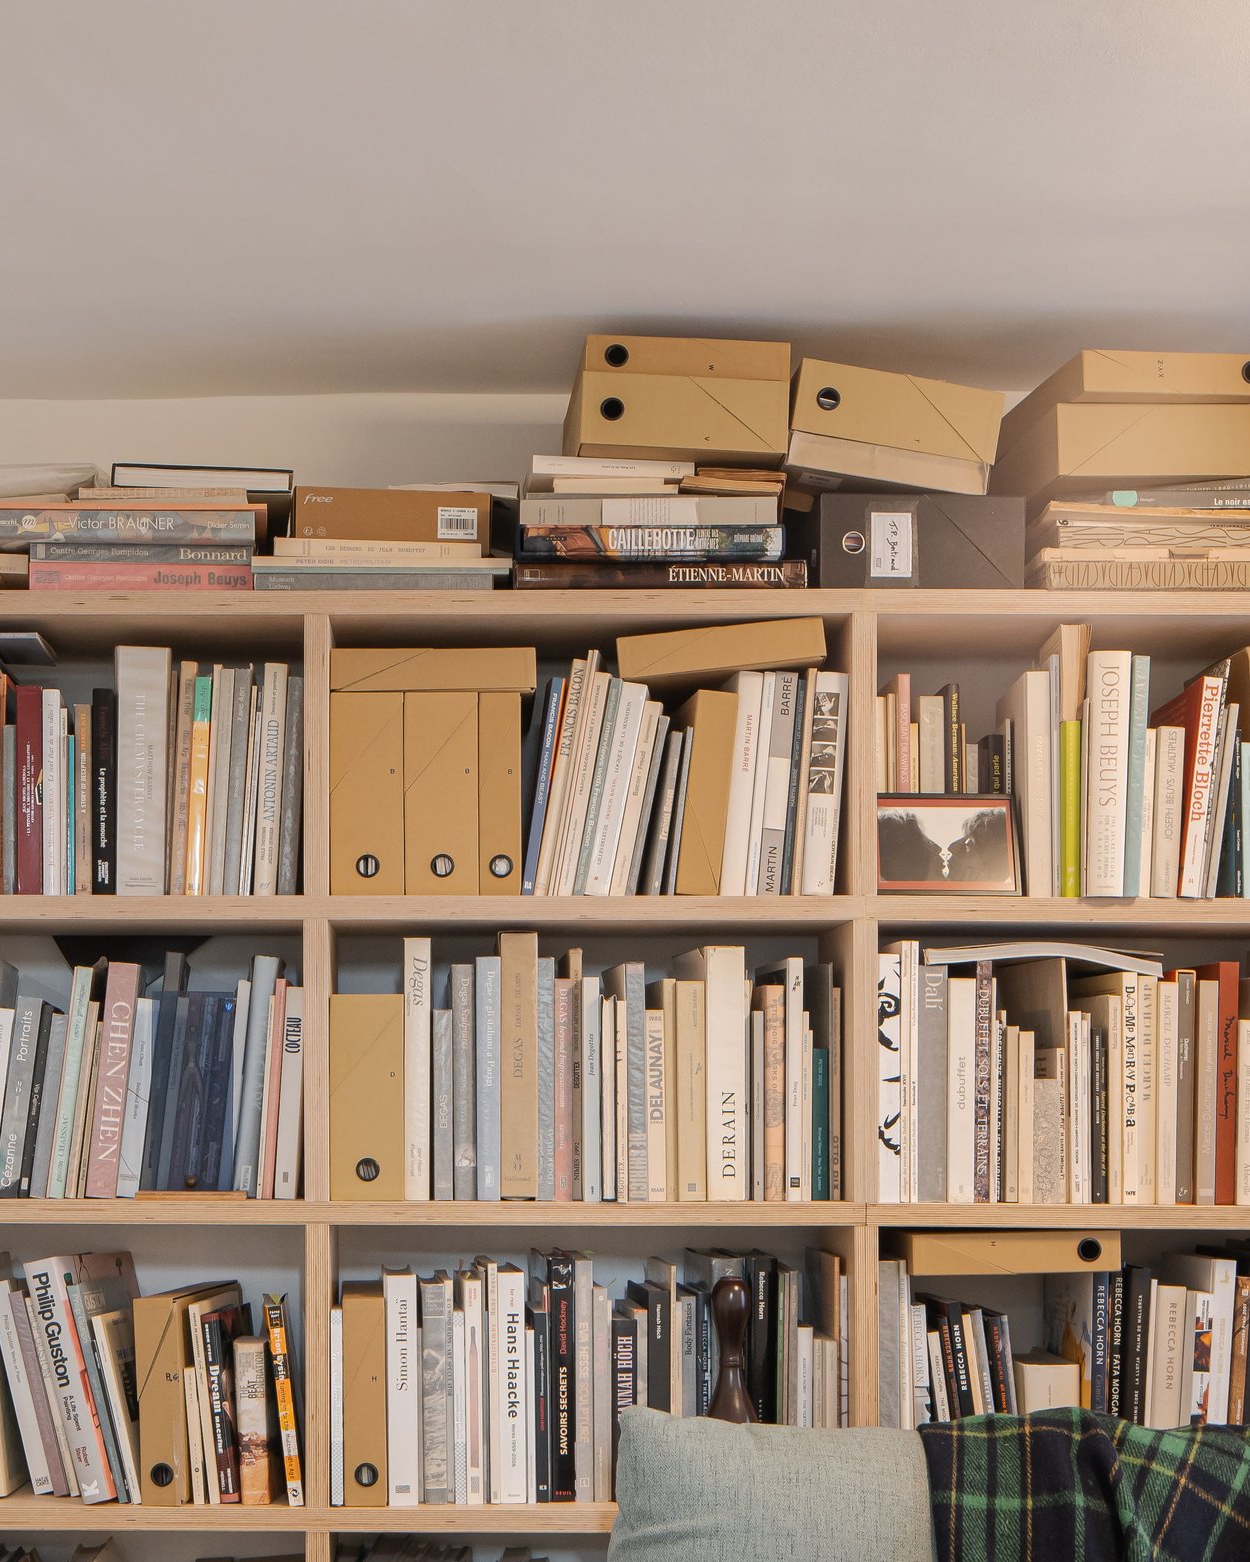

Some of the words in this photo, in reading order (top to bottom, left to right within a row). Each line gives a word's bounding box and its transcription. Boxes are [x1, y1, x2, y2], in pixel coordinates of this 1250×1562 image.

[304, 494, 334, 504] free
[1214, 498, 1223, 506] Le
[1225, 498, 1240, 506] noir
[68, 517, 105, 529] Victor
[109, 517, 174, 529] BRAUNER
[207, 521, 226, 529] Didier
[608, 529, 694, 550] CAILLEBOTTE
[50, 547, 76, 555] Centre
[78, 548, 107, 557] Georges
[109, 548, 148, 556] Pompidou
[180, 548, 247, 561] Bonnard
[669, 565, 784, 582] ÉTIENNE-MARTIN
[560, 708, 577, 757] FRANCIS
[569, 668, 584, 706] BACON
[1101, 663, 1119, 737] JOSEPH
[265, 719, 279, 766] ARTAUD
[598, 721, 612, 766] Interviews
[1196, 684, 1219, 765] Pierrette
[264, 769, 277, 822] ANTONIN
[595, 768, 604, 785] with
[766, 846, 777, 892] MARTIN
[780, 676, 792, 716] BARRÉ
[1099, 744, 1117, 806] BEUYS
[1191, 771, 1210, 822] Bloch
[589, 788, 602, 816] Francis
[585, 819, 596, 846] Bacon
[409, 956, 428, 1006] Degas
[925, 972, 942, 1009] Dalí
[284, 1017, 302, 1053] COCTEAU
[979, 989, 989, 1051] DUBUFFET
[1143, 984, 1151, 1045] DUCHAMP
[102, 1001, 130, 1078] CHEN
[649, 1035, 663, 1121] DELAUNAY
[957, 1056, 966, 1109] dubuffet
[978, 1057, 989, 1087] SOLS
[1143, 1050, 1151, 1101] MARCEL
[1, 1133, 17, 1187] Cézanne
[17, 1010, 32, 1061] Portraits
[439, 1094, 447, 1128] DEGAS
[978, 1094, 988, 1108] ET
[98, 1085, 122, 1162] ZHEN
[722, 1091, 736, 1178] DERAIN
[977, 1116, 988, 1174] TERRAINS
[32, 1272, 54, 1321] Philip
[47, 1322, 70, 1387] Guston
[395, 1299, 407, 1343] Hantaï
[560, 1300, 568, 1332] Hockney
[1096, 1286, 1104, 1331] REBECCA
[1168, 1303, 1177, 1352] REBECCA
[506, 1313, 518, 1354] Hans
[953, 1324, 961, 1348] HORN
[1096, 1335, 1104, 1365] HORN
[248, 1380, 256, 1399] BEAT
[255, 1352, 264, 1399] GENERATION
[396, 1347, 408, 1391] Simon
[507, 1359, 520, 1418] Haacke
[559, 1367, 567, 1410] SECRETS
[957, 1352, 967, 1391] REBECCA
[1165, 1357, 1175, 1389] HORN
[63, 1396, 73, 1420] Painting
[71, 1415, 81, 1431] Spent
[75, 1447, 83, 1462] Storr
[560, 1412, 568, 1455] SAVOIRS
[80, 1446, 90, 1466] Robert
